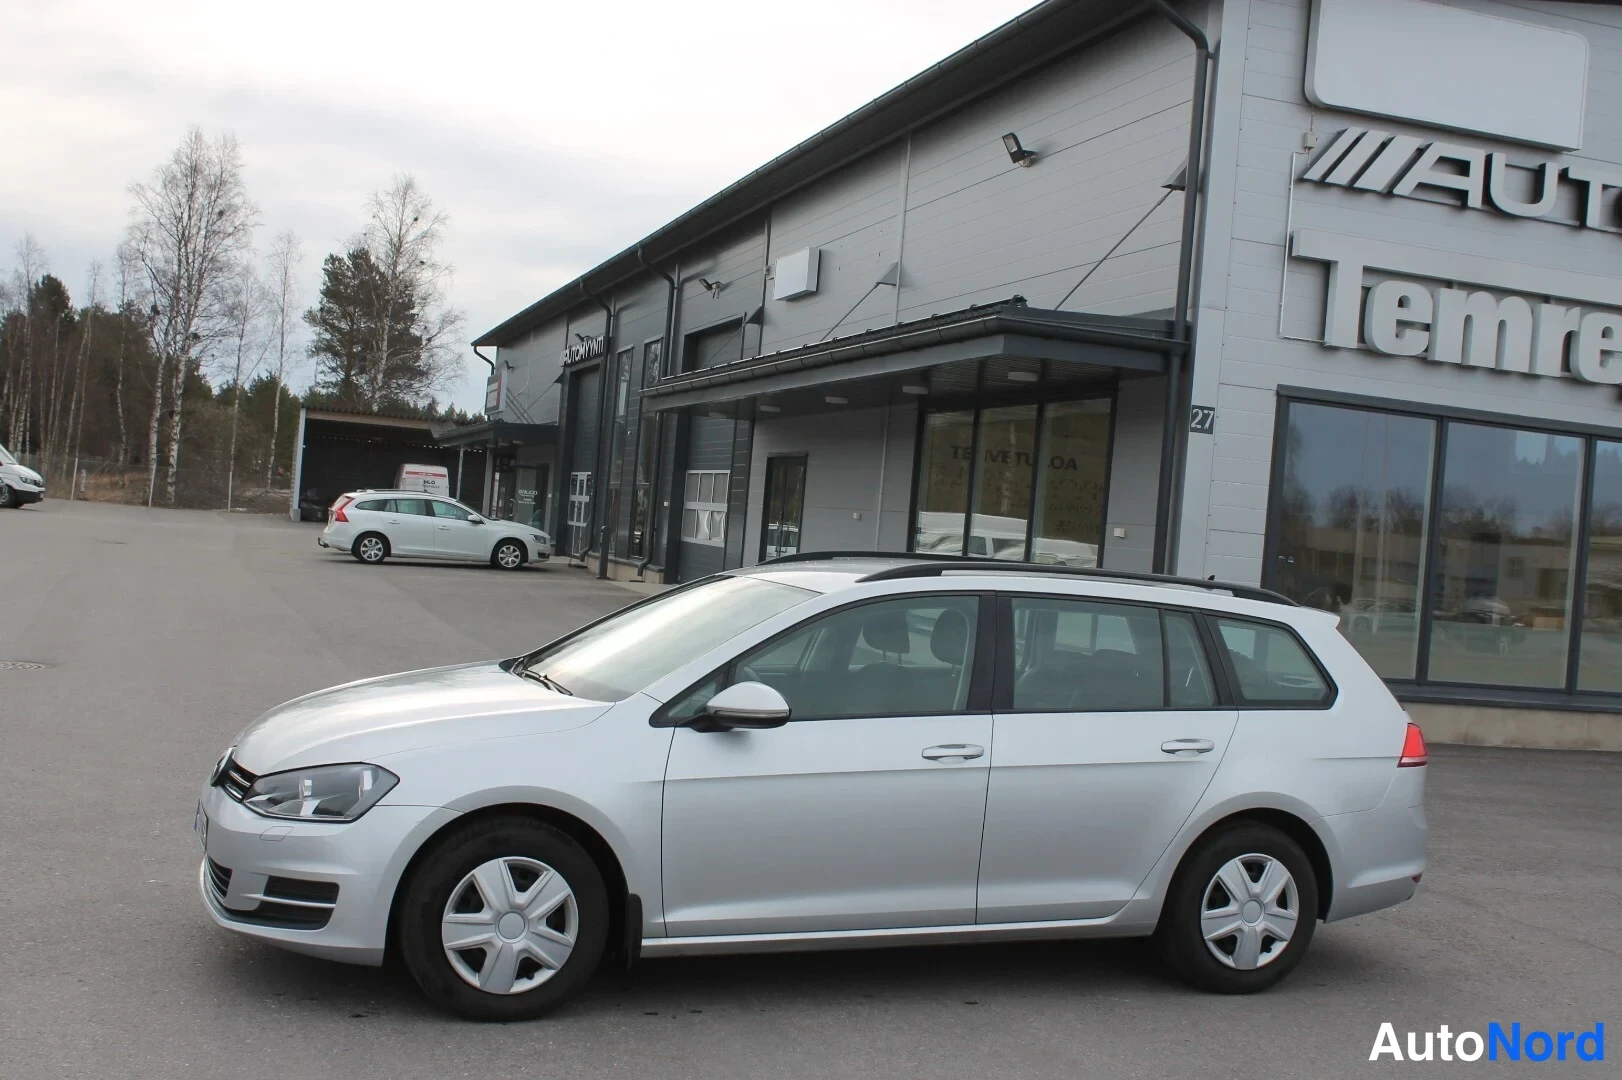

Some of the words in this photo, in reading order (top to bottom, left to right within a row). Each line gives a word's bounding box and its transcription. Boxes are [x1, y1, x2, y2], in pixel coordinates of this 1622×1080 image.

[1391, 141, 1622, 231] AUT
[1190, 408, 1215, 430] 27
[949, 445, 1078, 472] TEVETUOA
